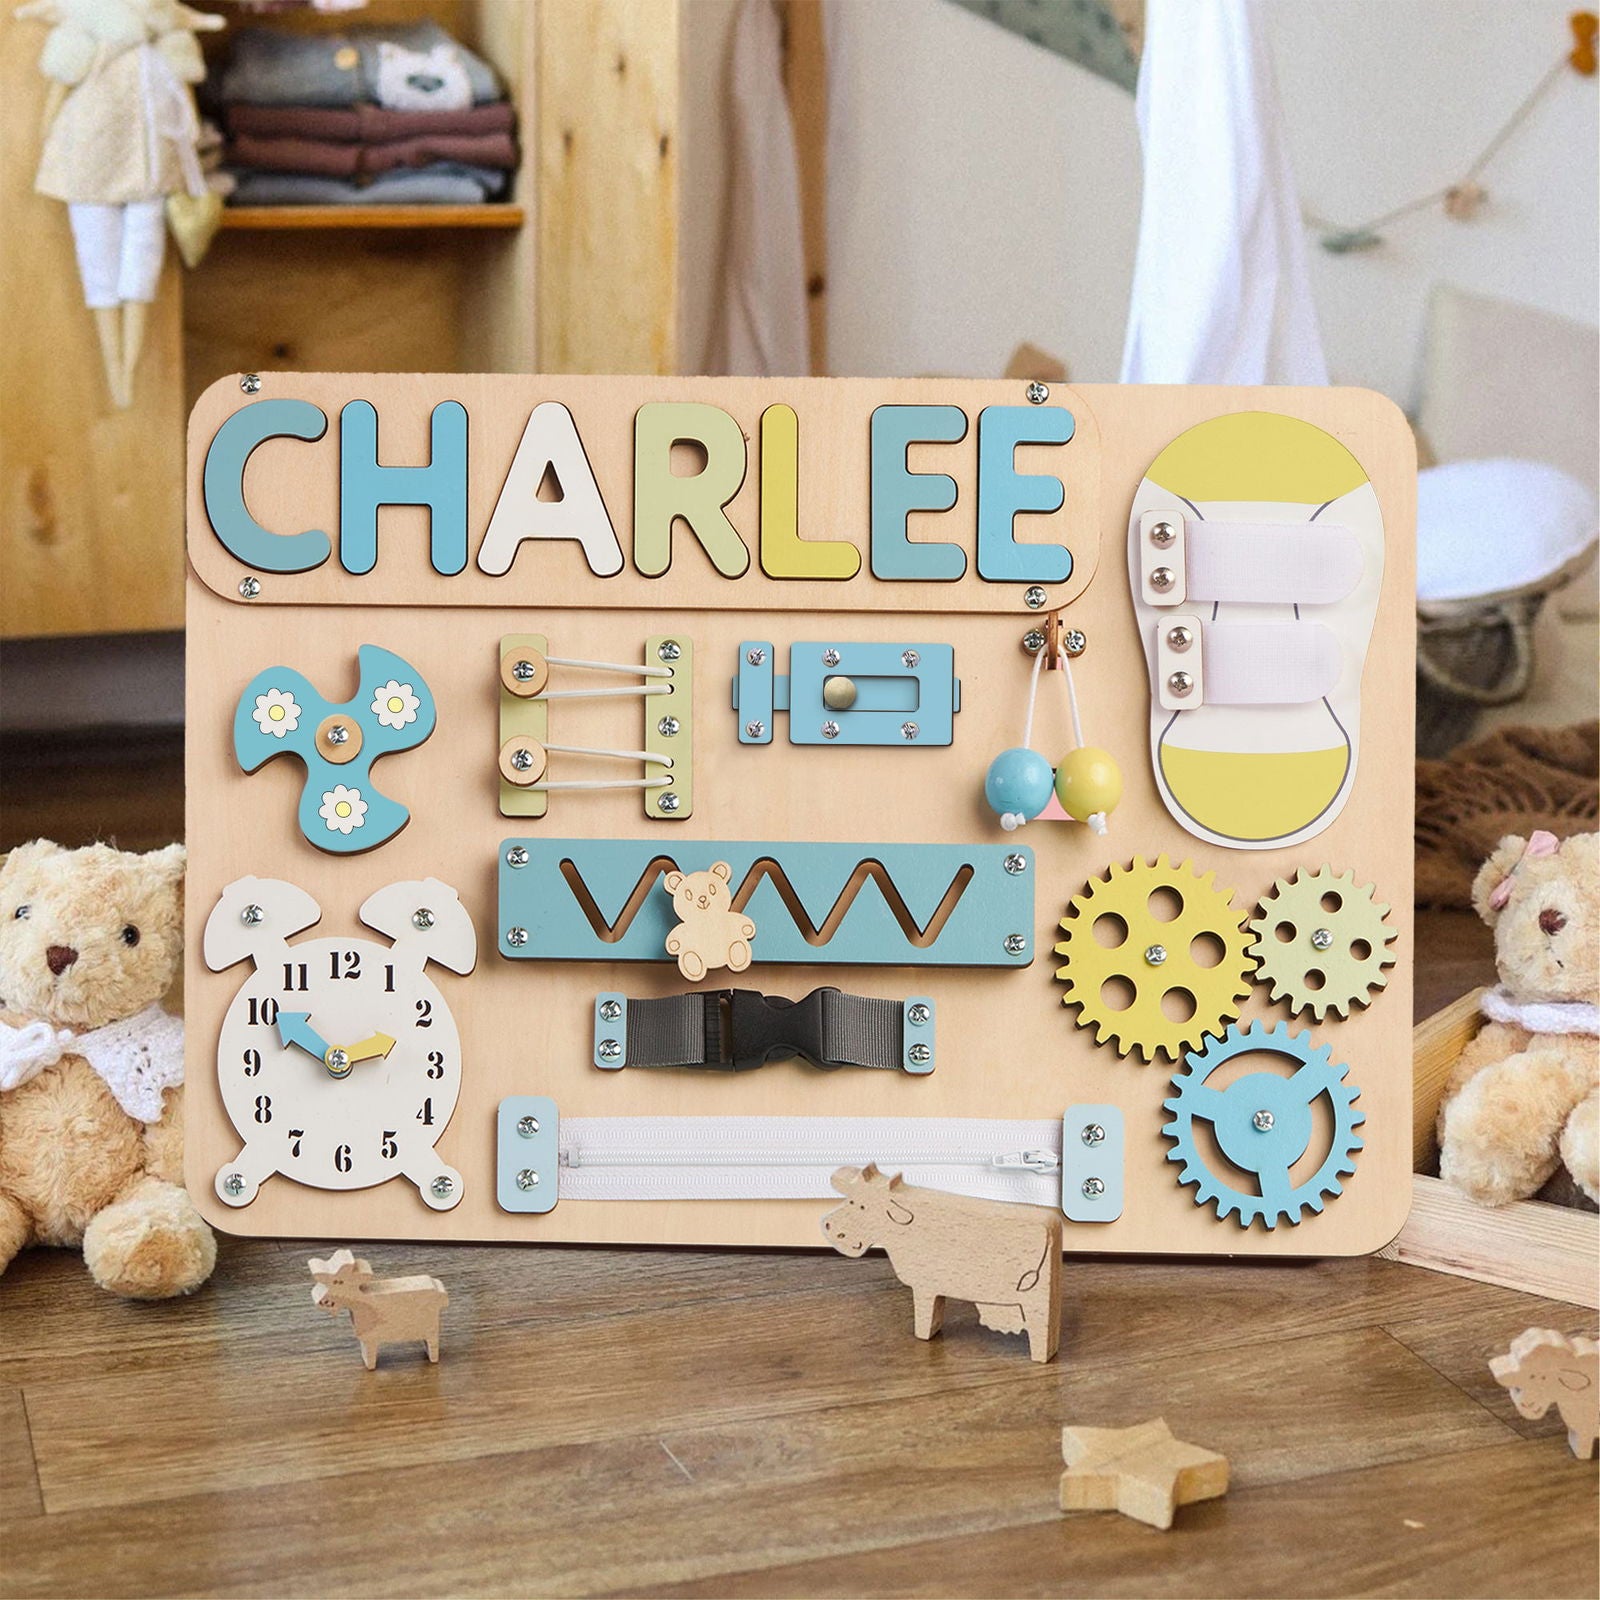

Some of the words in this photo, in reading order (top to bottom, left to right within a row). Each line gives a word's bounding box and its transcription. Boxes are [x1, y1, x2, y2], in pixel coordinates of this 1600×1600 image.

[204, 399, 1076, 583] CHARLEE
[283, 963, 309, 991] 11
[329, 951, 361, 979] 12
[384, 965, 396, 992] 1
[248, 998, 279, 1026] 10
[416, 1000, 432, 1028] 2
[243, 1049, 261, 1077] 9
[427, 1051, 444, 1079] 3
[255, 1095, 272, 1123] 8
[416, 1098, 434, 1125] 4
[288, 1129, 304, 1157] 7
[382, 1131, 398, 1159] 5
[335, 1145, 352, 1173] 6
